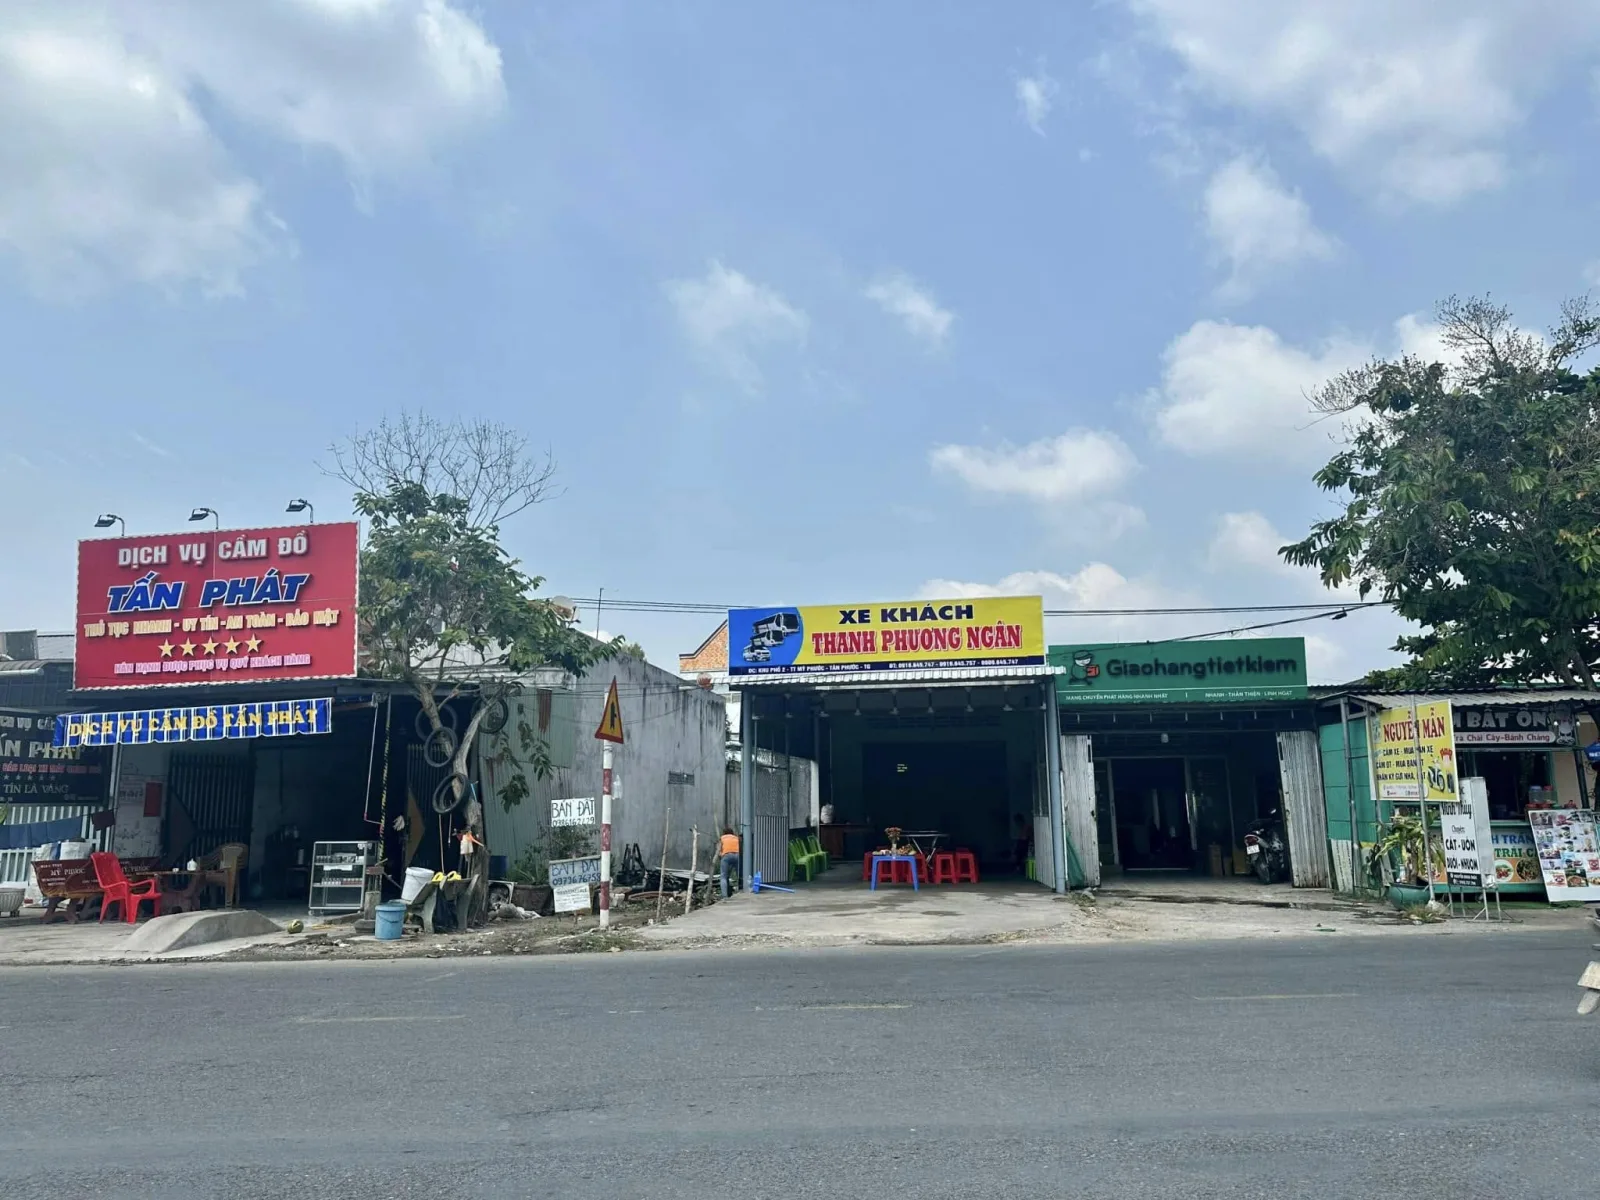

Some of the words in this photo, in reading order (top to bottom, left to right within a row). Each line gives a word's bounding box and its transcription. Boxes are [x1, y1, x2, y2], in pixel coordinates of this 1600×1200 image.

[118, 546, 167, 569] DỊCH
[179, 543, 206, 565] VỤ
[218, 534, 267, 559] CẦM
[278, 530, 308, 556] ĐỒ
[107, 570, 185, 613] TẤN
[199, 567, 311, 608] PHÁT
[84, 619, 105, 637] THỦ
[108, 621, 129, 638] TỤC
[133, 619, 172, 635] NHANH
[182, 617, 198, 632] UY
[200, 614, 219, 631] TÍN
[226, 615, 243, 629] AN
[245, 611, 276, 628] TOÀN
[285, 608, 309, 627] BẢO
[313, 607, 339, 626] MẬT
[839, 609, 871, 624] XE
[881, 603, 974, 623] KHÁCH
[812, 630, 877, 656] THANH
[881, 627, 962, 655] PHƯƠNG
[966, 620, 1022, 649] NGÂN
[135, 661, 161, 675] HẠNH
[162, 660, 188, 674] ĐƯỢC
[189, 659, 214, 672] PHỤC
[215, 658, 229, 671] VỤ
[230, 656, 249, 669] QUÝ
[250, 655, 282, 668] KHÁCH
[284, 653, 311, 666] HÀNG
[120, 718, 143, 737] VỤ
[267, 705, 318, 726] PHÁT
